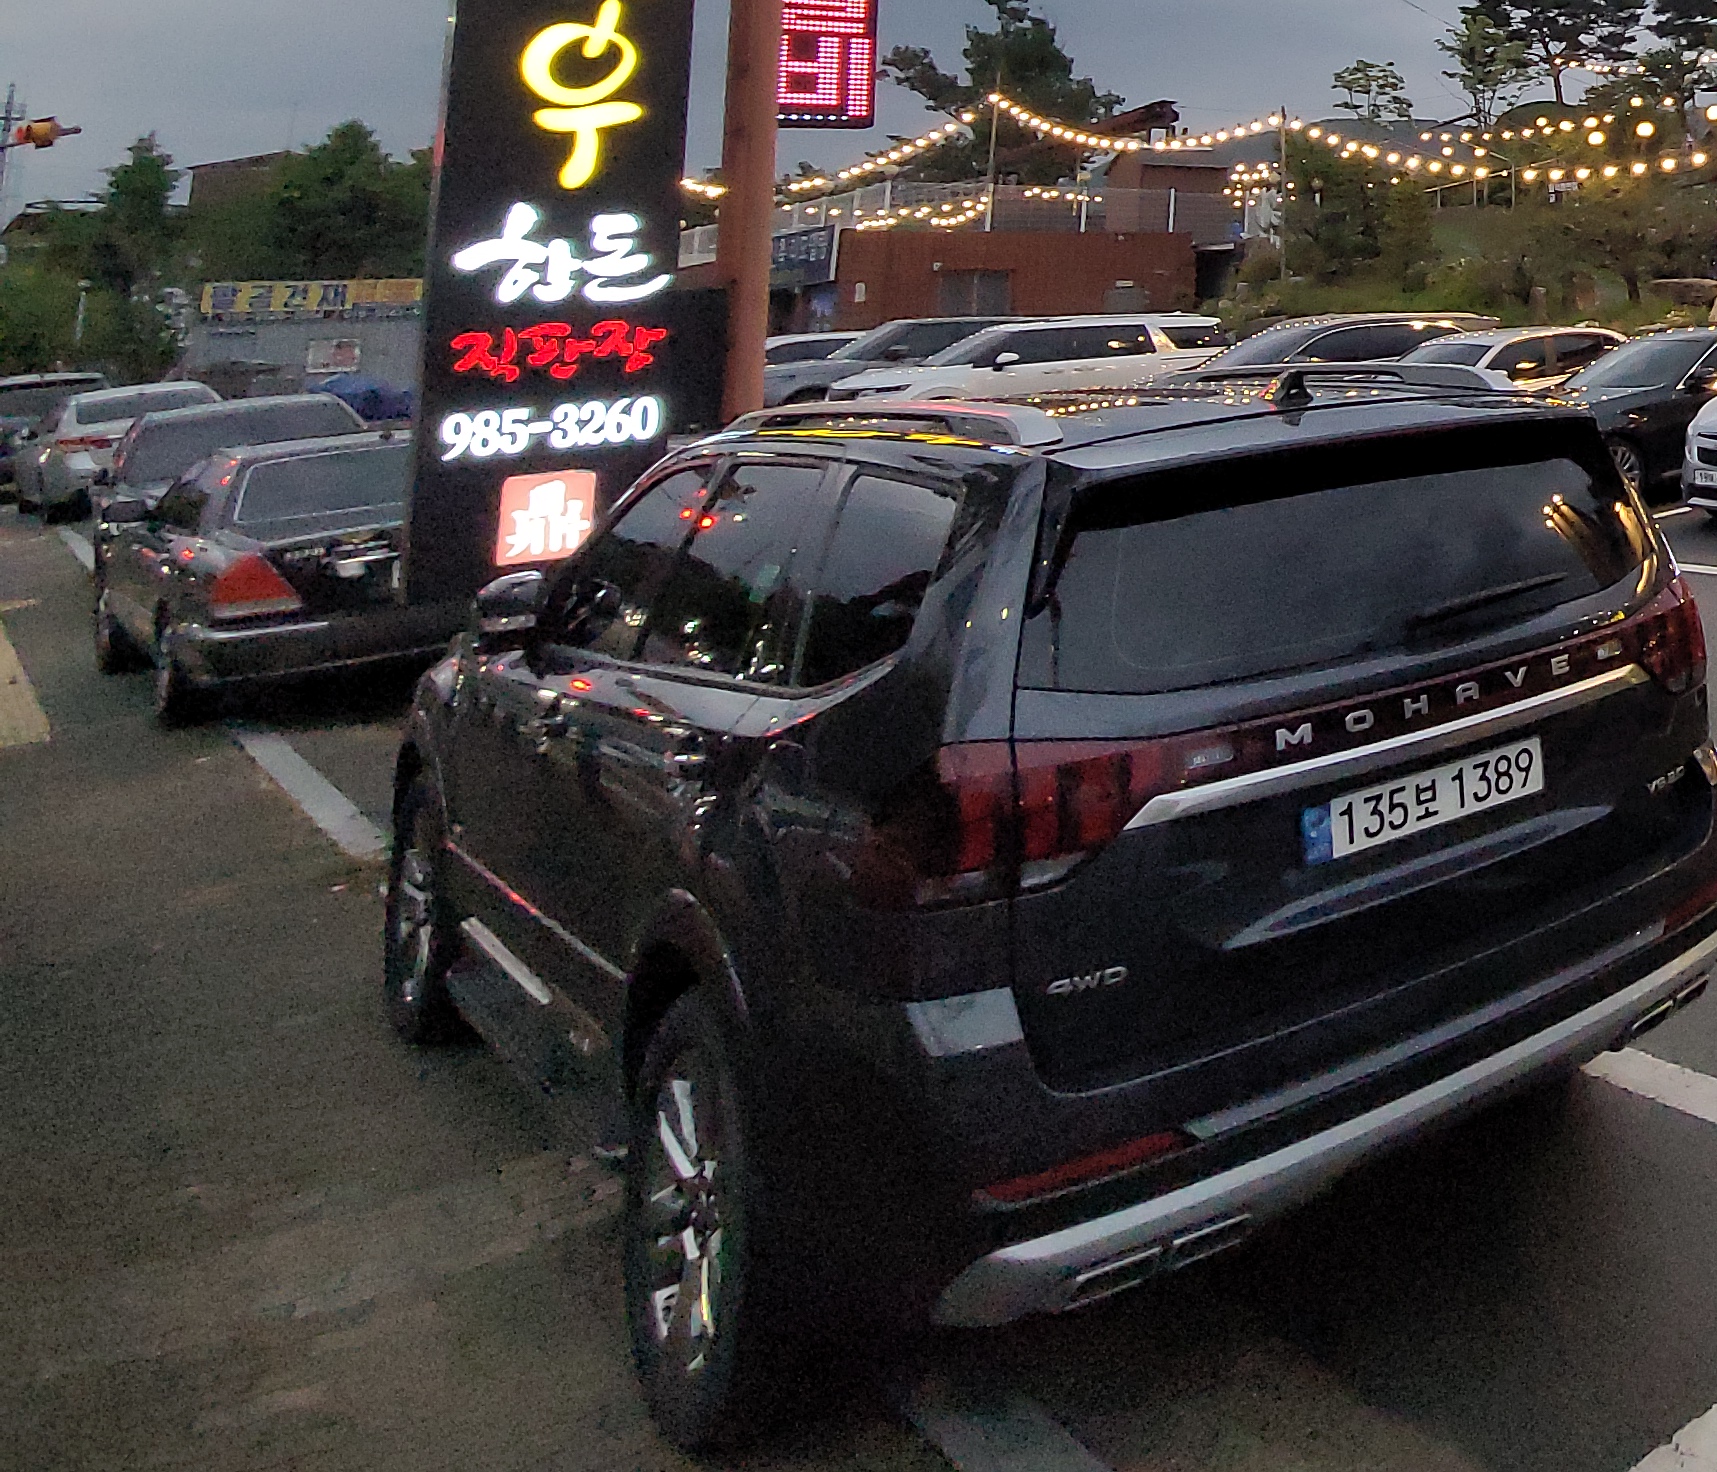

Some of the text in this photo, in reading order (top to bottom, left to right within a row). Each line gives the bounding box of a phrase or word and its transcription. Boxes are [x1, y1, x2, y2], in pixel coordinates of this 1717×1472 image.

[451, 201, 675, 303] 한돈
[450, 320, 668, 383] 직판장
[441, 395, 660, 461] 985-3260
[1276, 653, 1570, 751] MOHAVE
[1338, 747, 1534, 846] 135보 1389
[1045, 966, 1129, 996] 4WD
